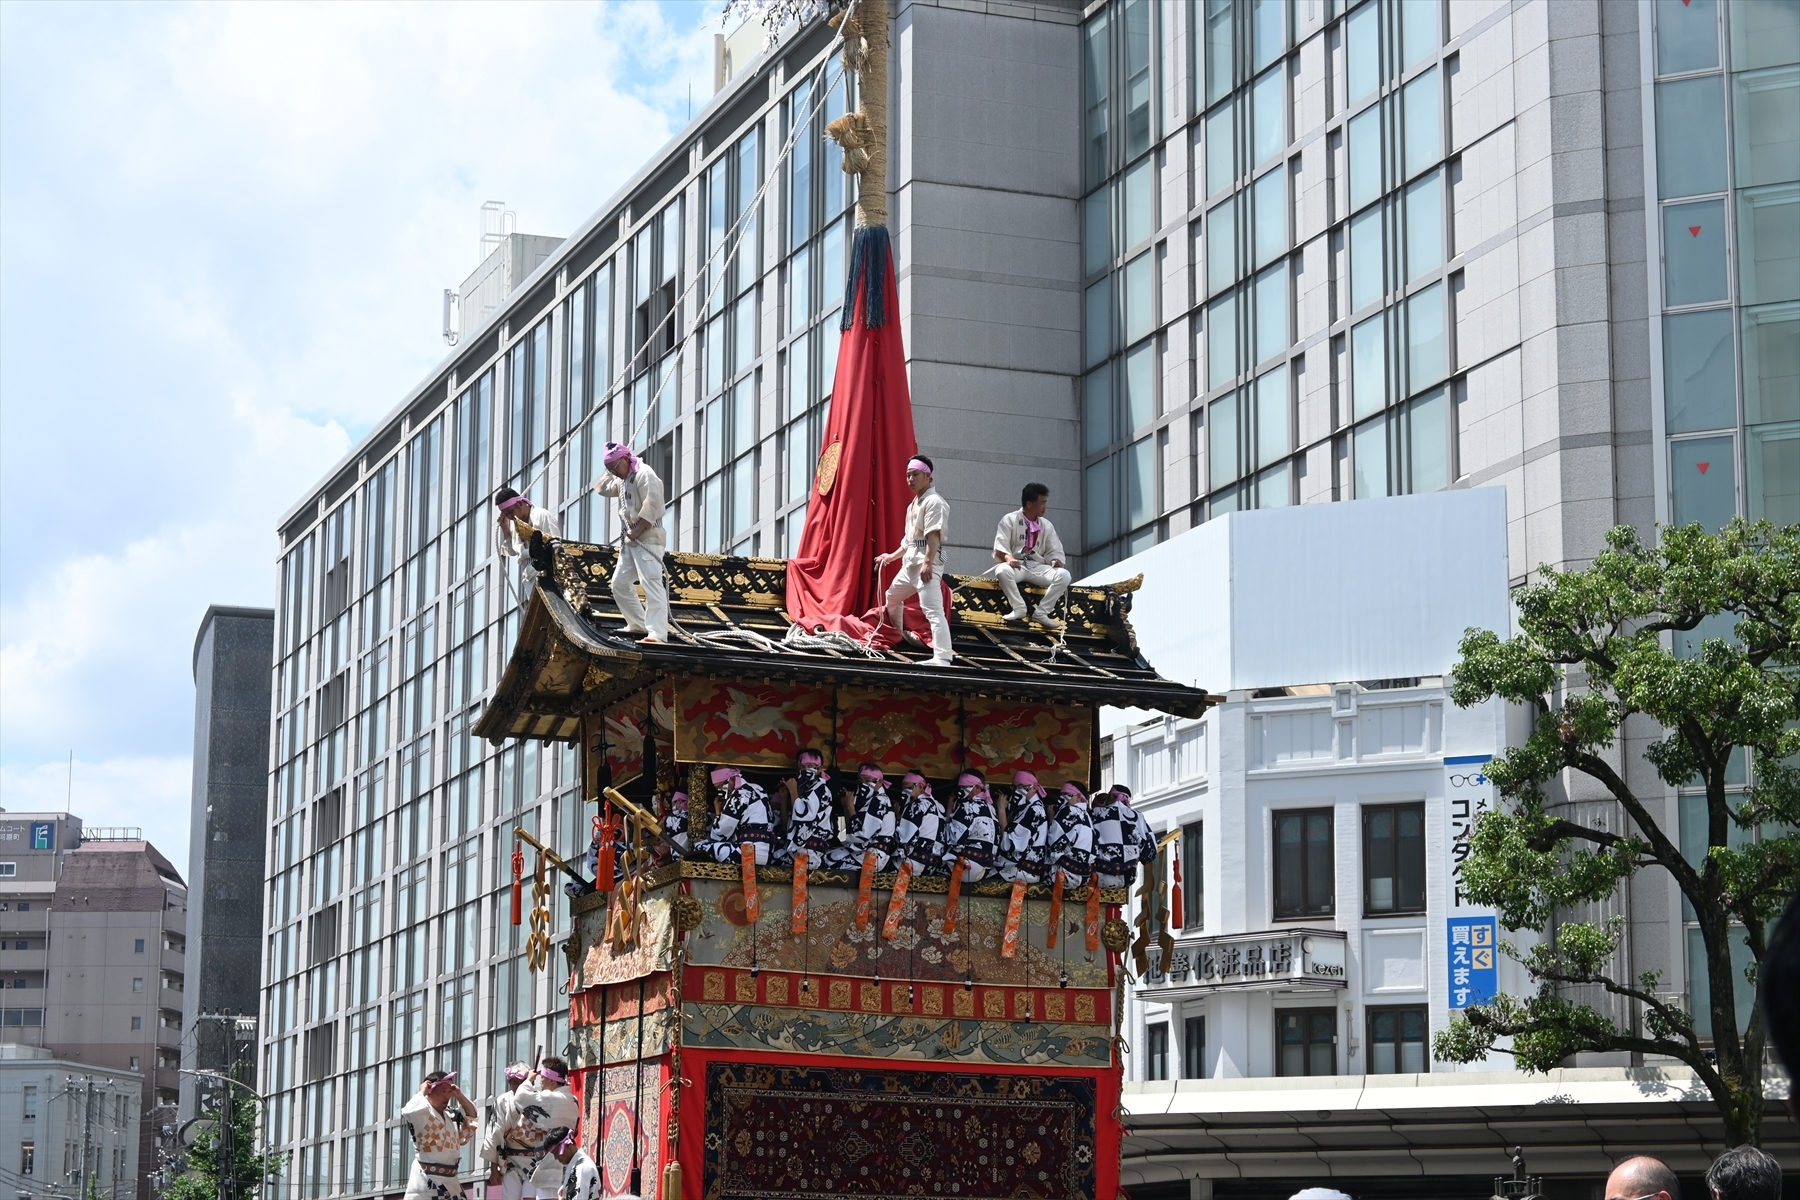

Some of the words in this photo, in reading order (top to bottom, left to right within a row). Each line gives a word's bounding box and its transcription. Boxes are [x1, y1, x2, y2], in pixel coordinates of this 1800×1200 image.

[1452, 925, 1471, 1006] 買えます
[1473, 926, 1490, 968] すぐ
